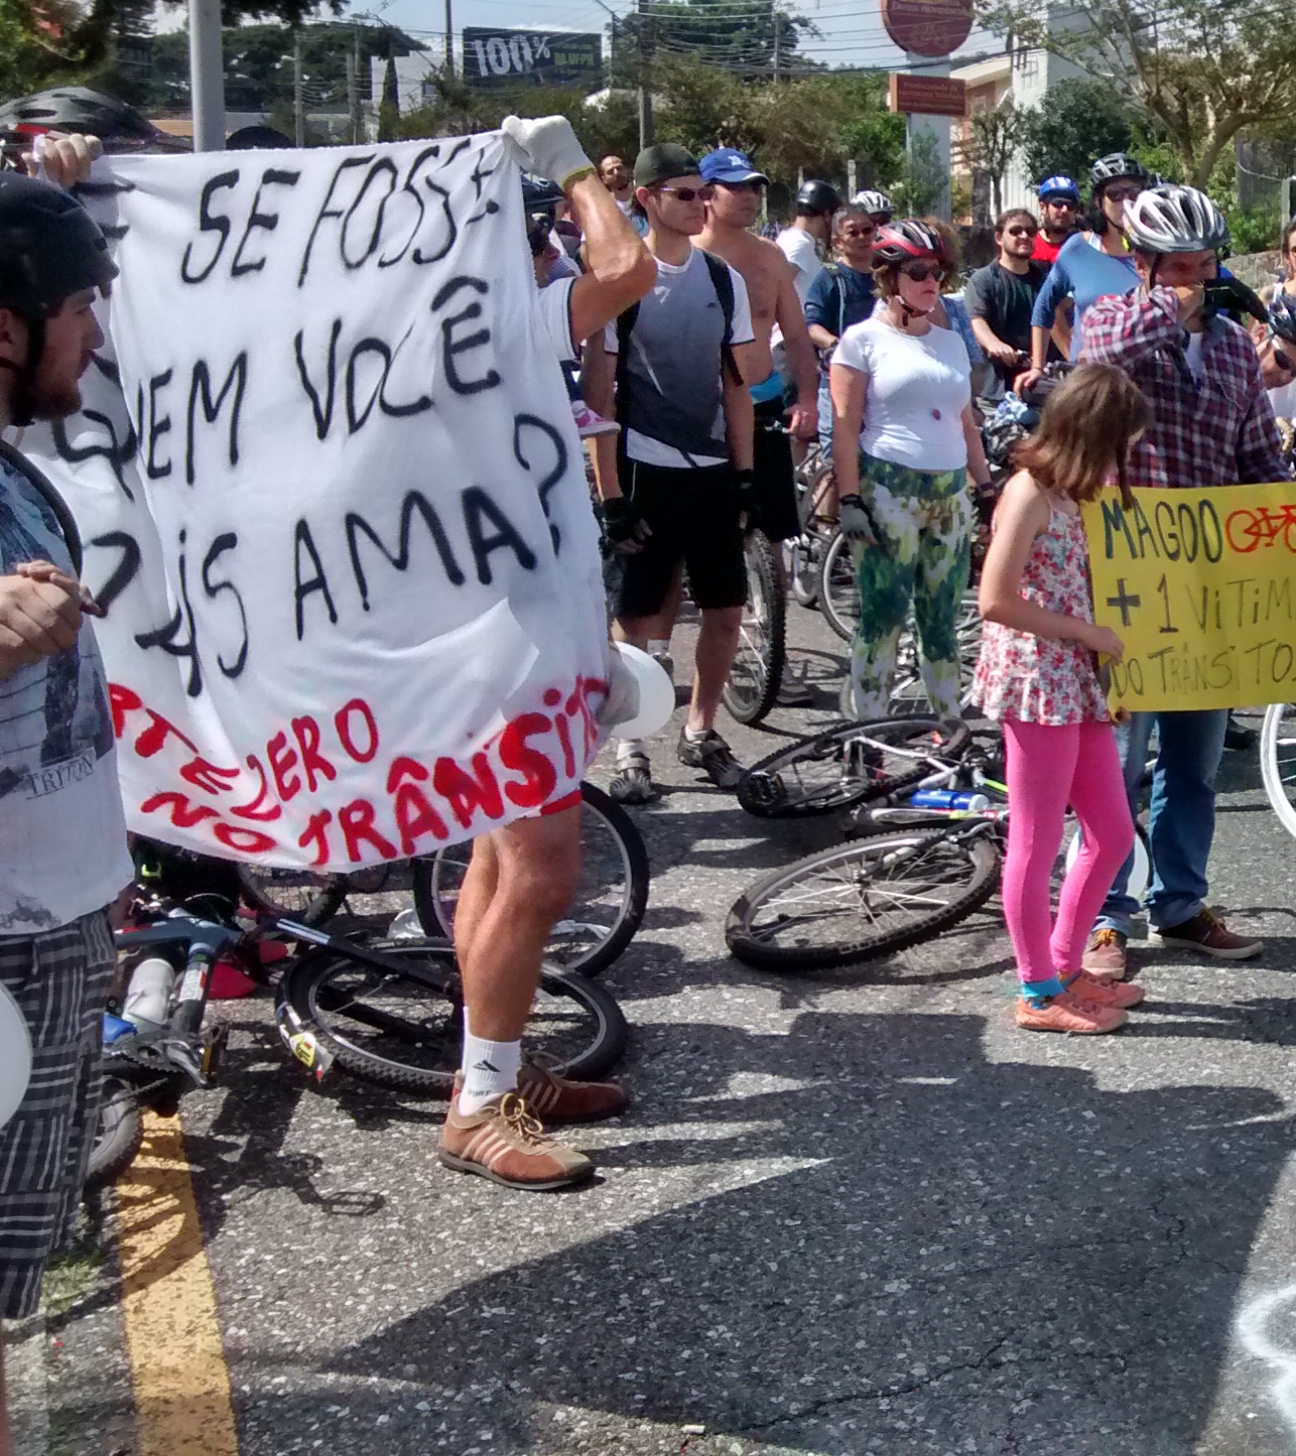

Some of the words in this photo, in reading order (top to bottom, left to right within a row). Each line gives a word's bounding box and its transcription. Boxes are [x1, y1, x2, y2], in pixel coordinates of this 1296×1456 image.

[181, 168, 302, 284] SE
[298, 138, 500, 289] FOSSE
[294, 276, 502, 441] VOCÊ
[1099, 497, 1224, 564] MAGOO
[1107, 656, 1144, 699] DO
[229, 697, 380, 822] ZERO
[140, 791, 277, 853] NO
